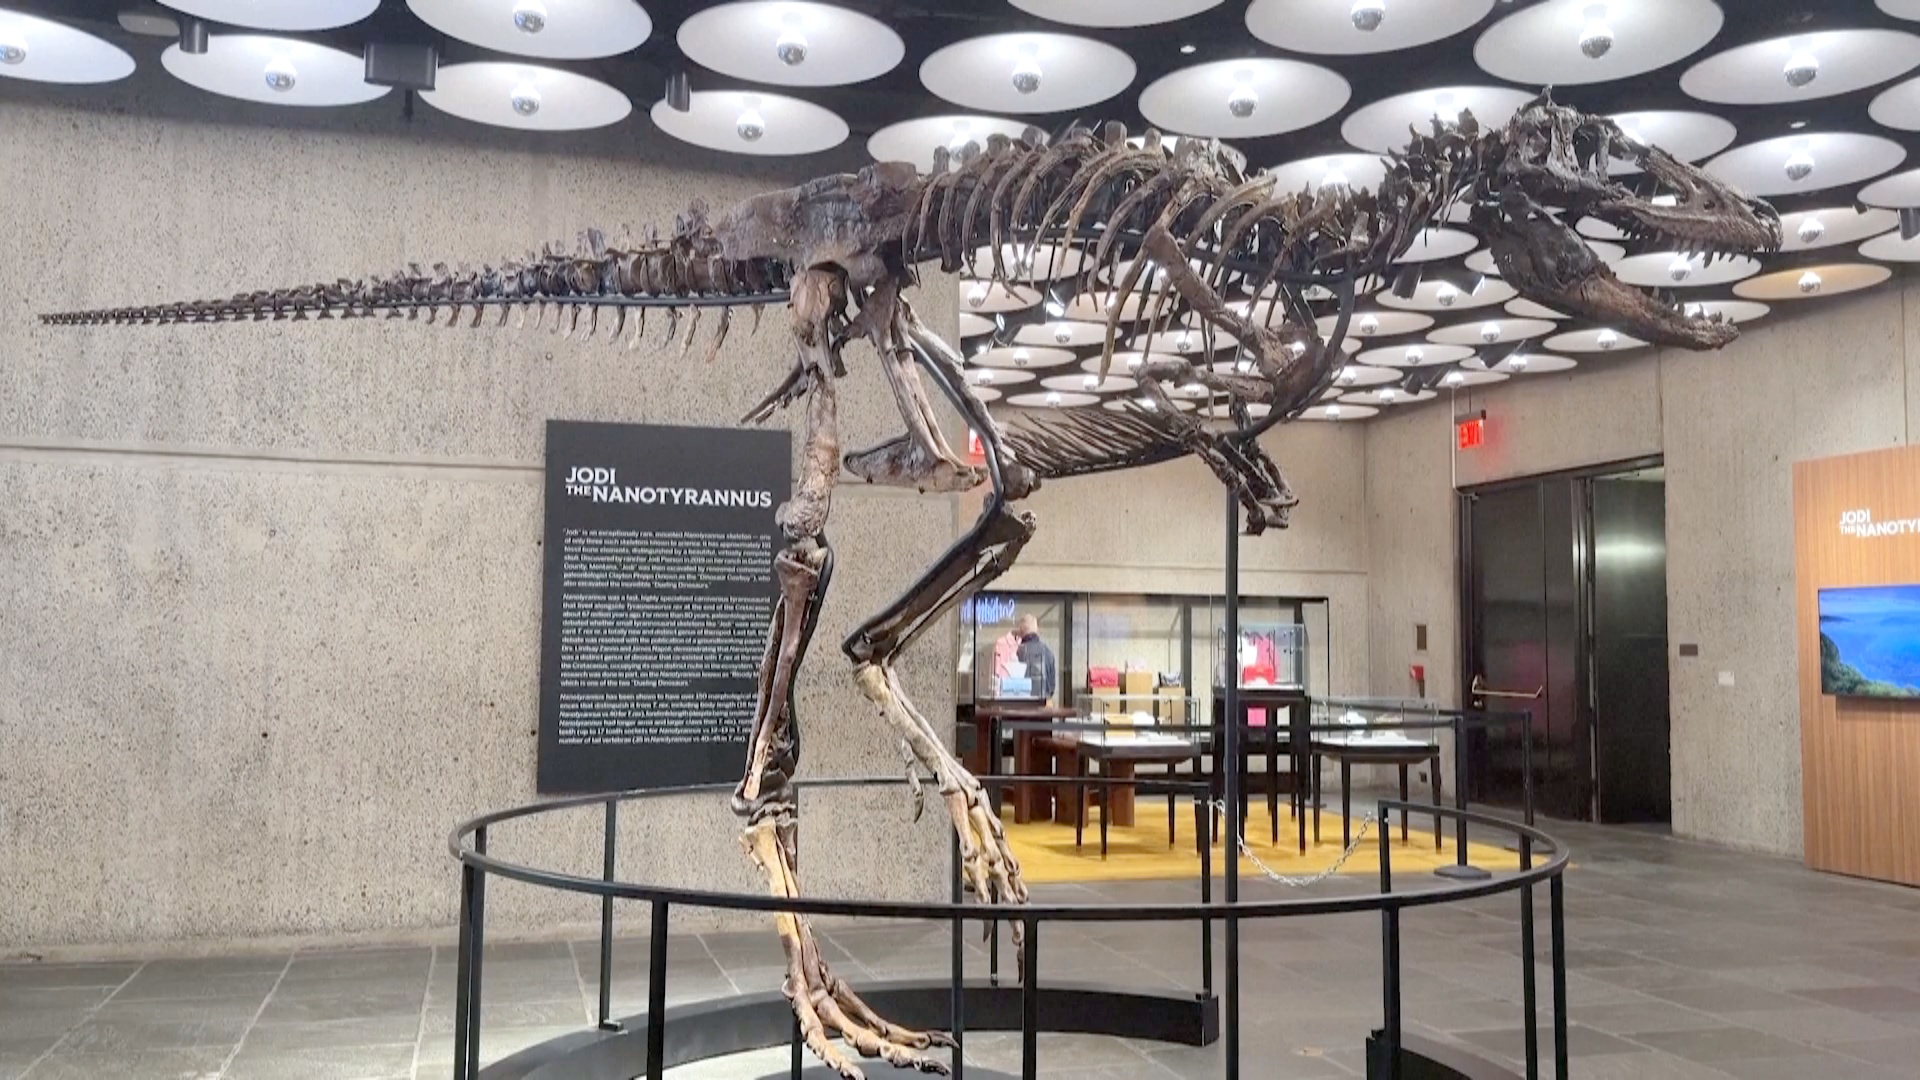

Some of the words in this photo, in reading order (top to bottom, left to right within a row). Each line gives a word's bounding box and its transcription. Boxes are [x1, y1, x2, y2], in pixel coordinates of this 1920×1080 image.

[565, 466, 616, 485] JODI
[565, 485, 591, 496] THE
[592, 486, 772, 508] NANOTYRANNUS
[1839, 509, 1870, 525] JODI
[1839, 525, 1857, 534] THE
